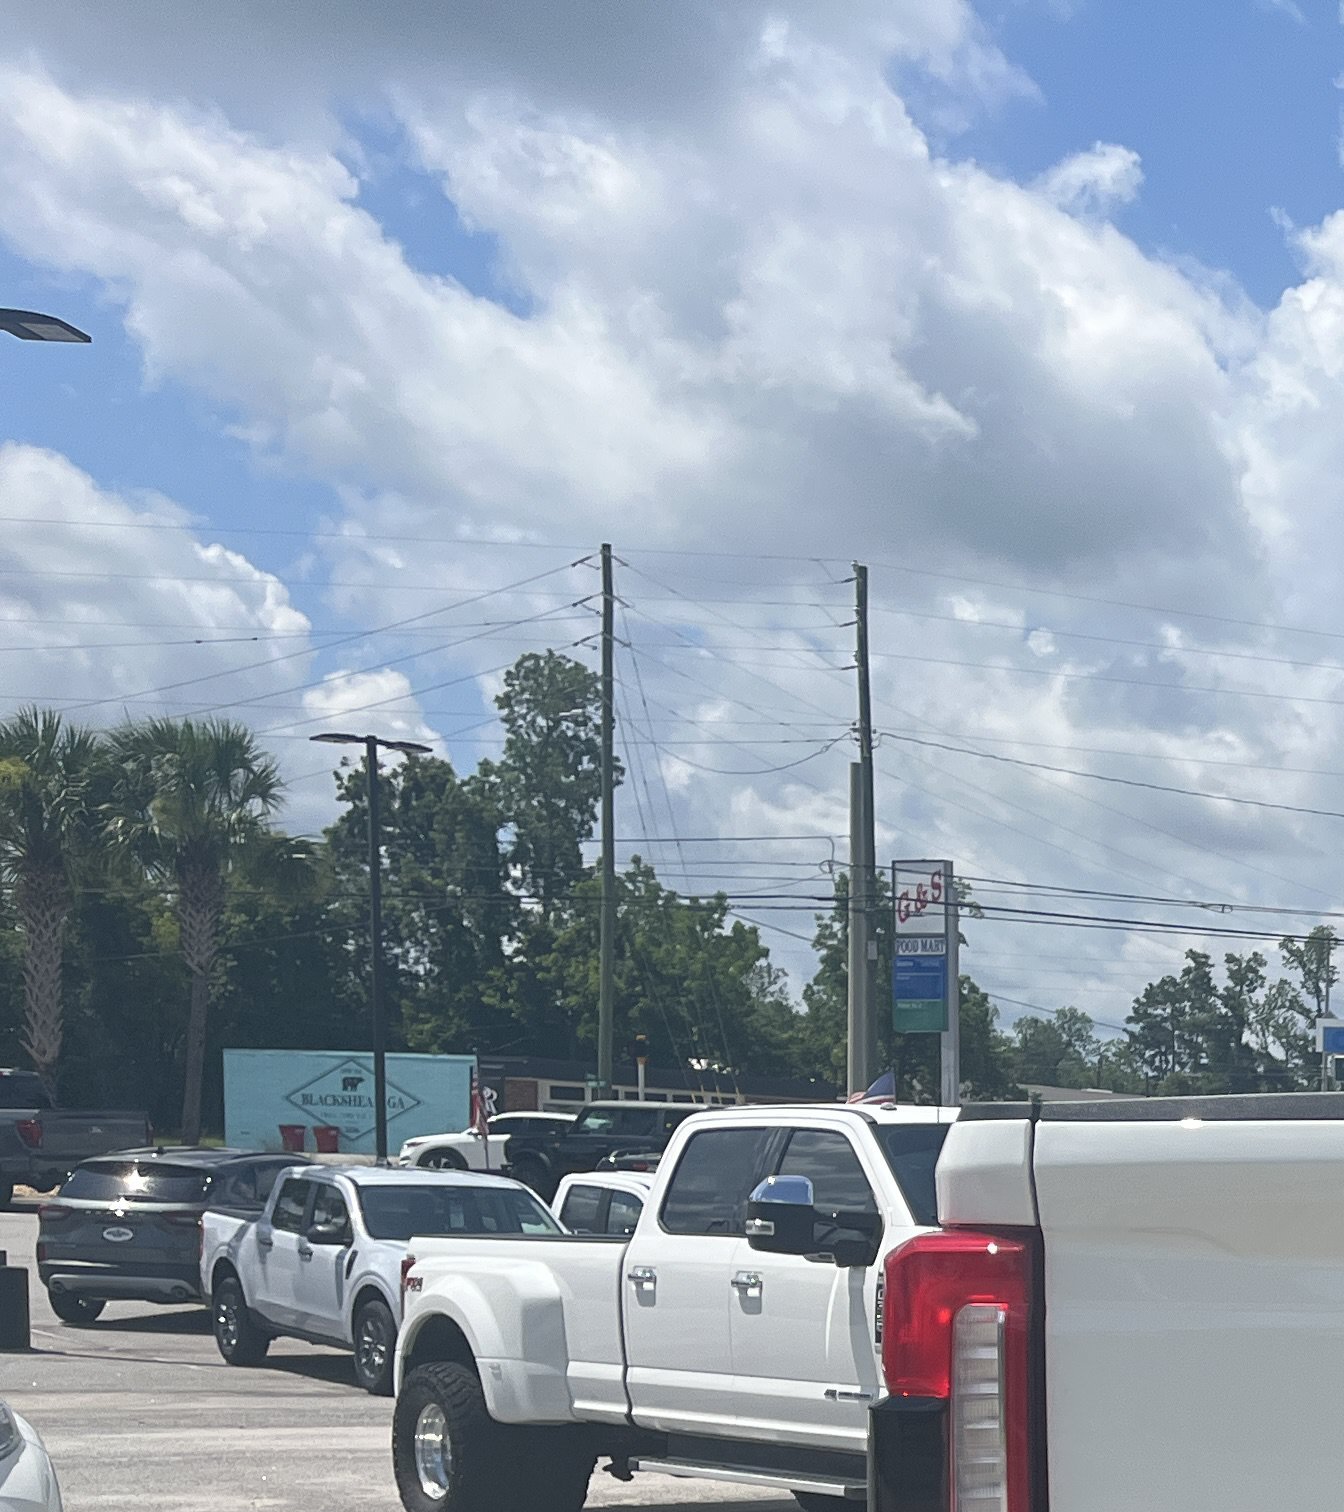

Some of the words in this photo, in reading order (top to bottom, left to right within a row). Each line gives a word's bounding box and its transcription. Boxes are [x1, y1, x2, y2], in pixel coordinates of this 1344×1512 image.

[897, 940, 919, 953] FOOD
[921, 938, 945, 953] MART
[301, 1094, 375, 1108] BLACKSHEA
